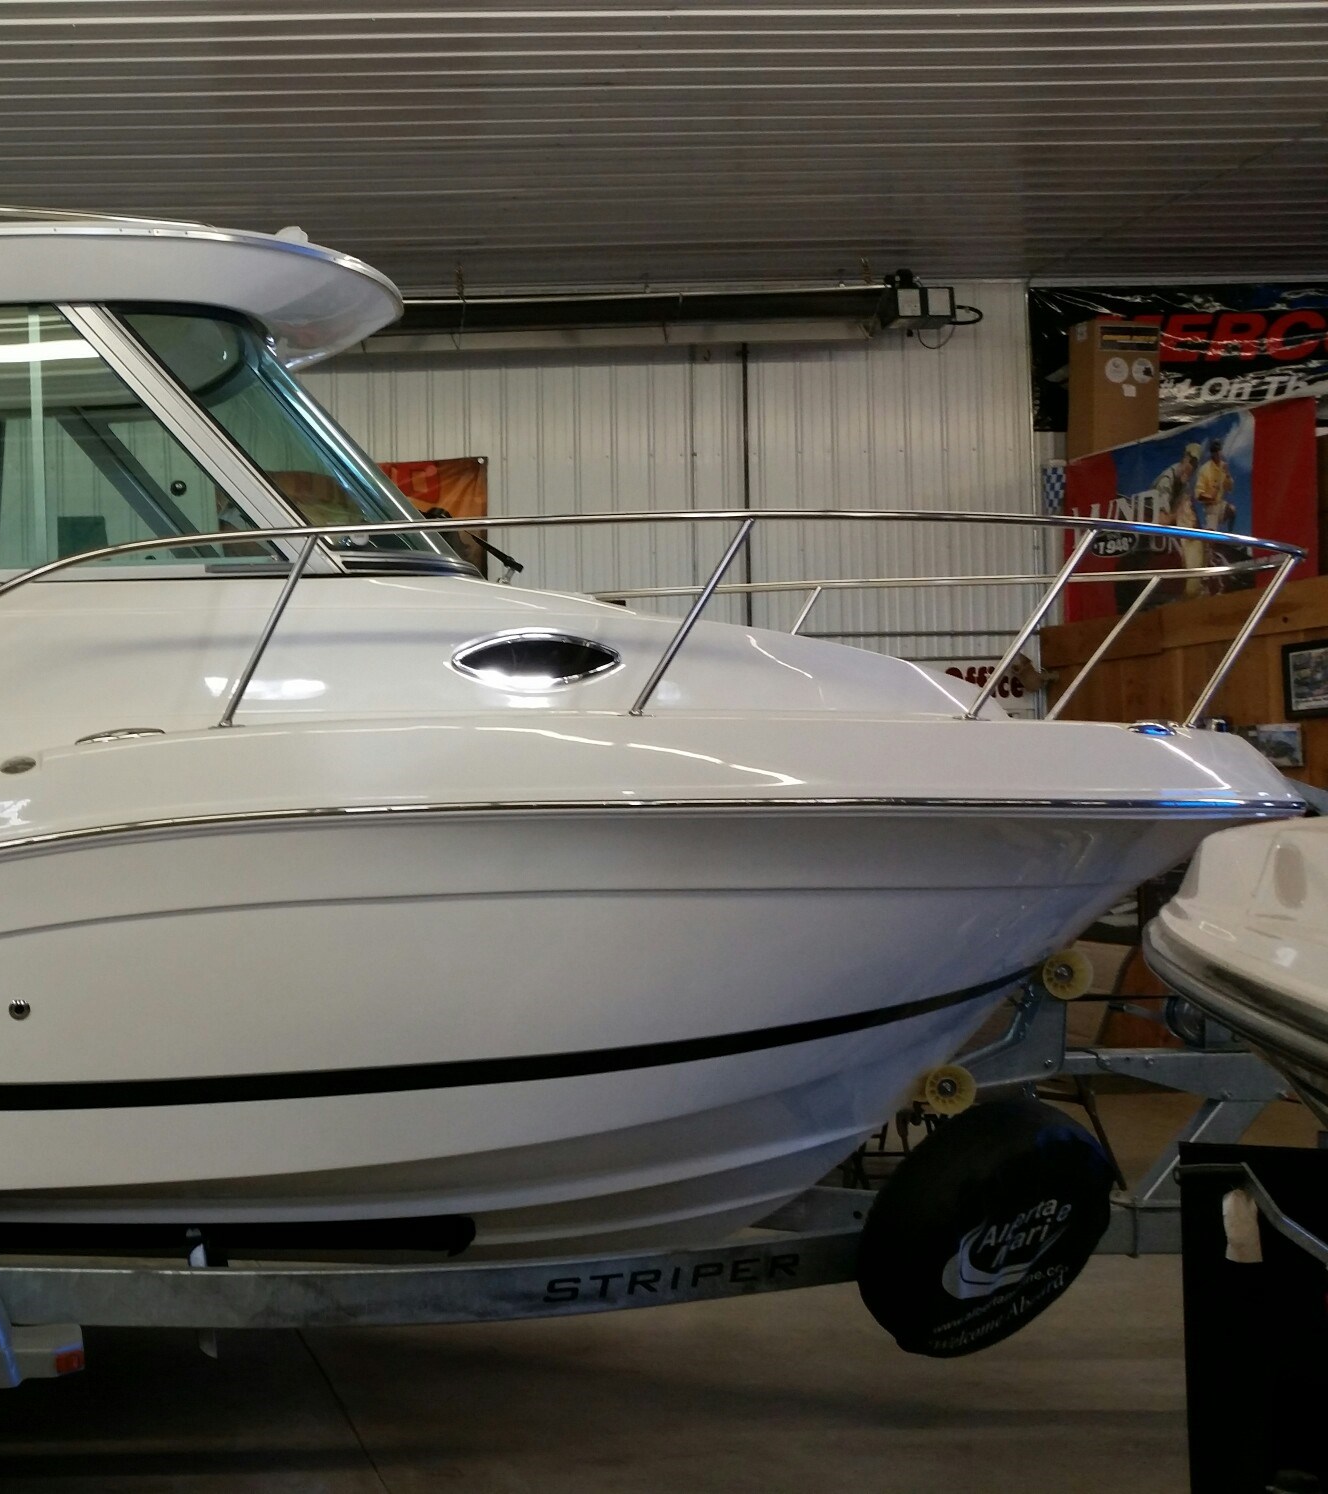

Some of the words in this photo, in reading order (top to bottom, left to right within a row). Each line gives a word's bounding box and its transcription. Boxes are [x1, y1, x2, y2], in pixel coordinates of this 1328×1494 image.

[1096, 311, 1328, 362] ERC
[945, 666, 1024, 698] ffce
[543, 1253, 800, 1303] STRIPER
